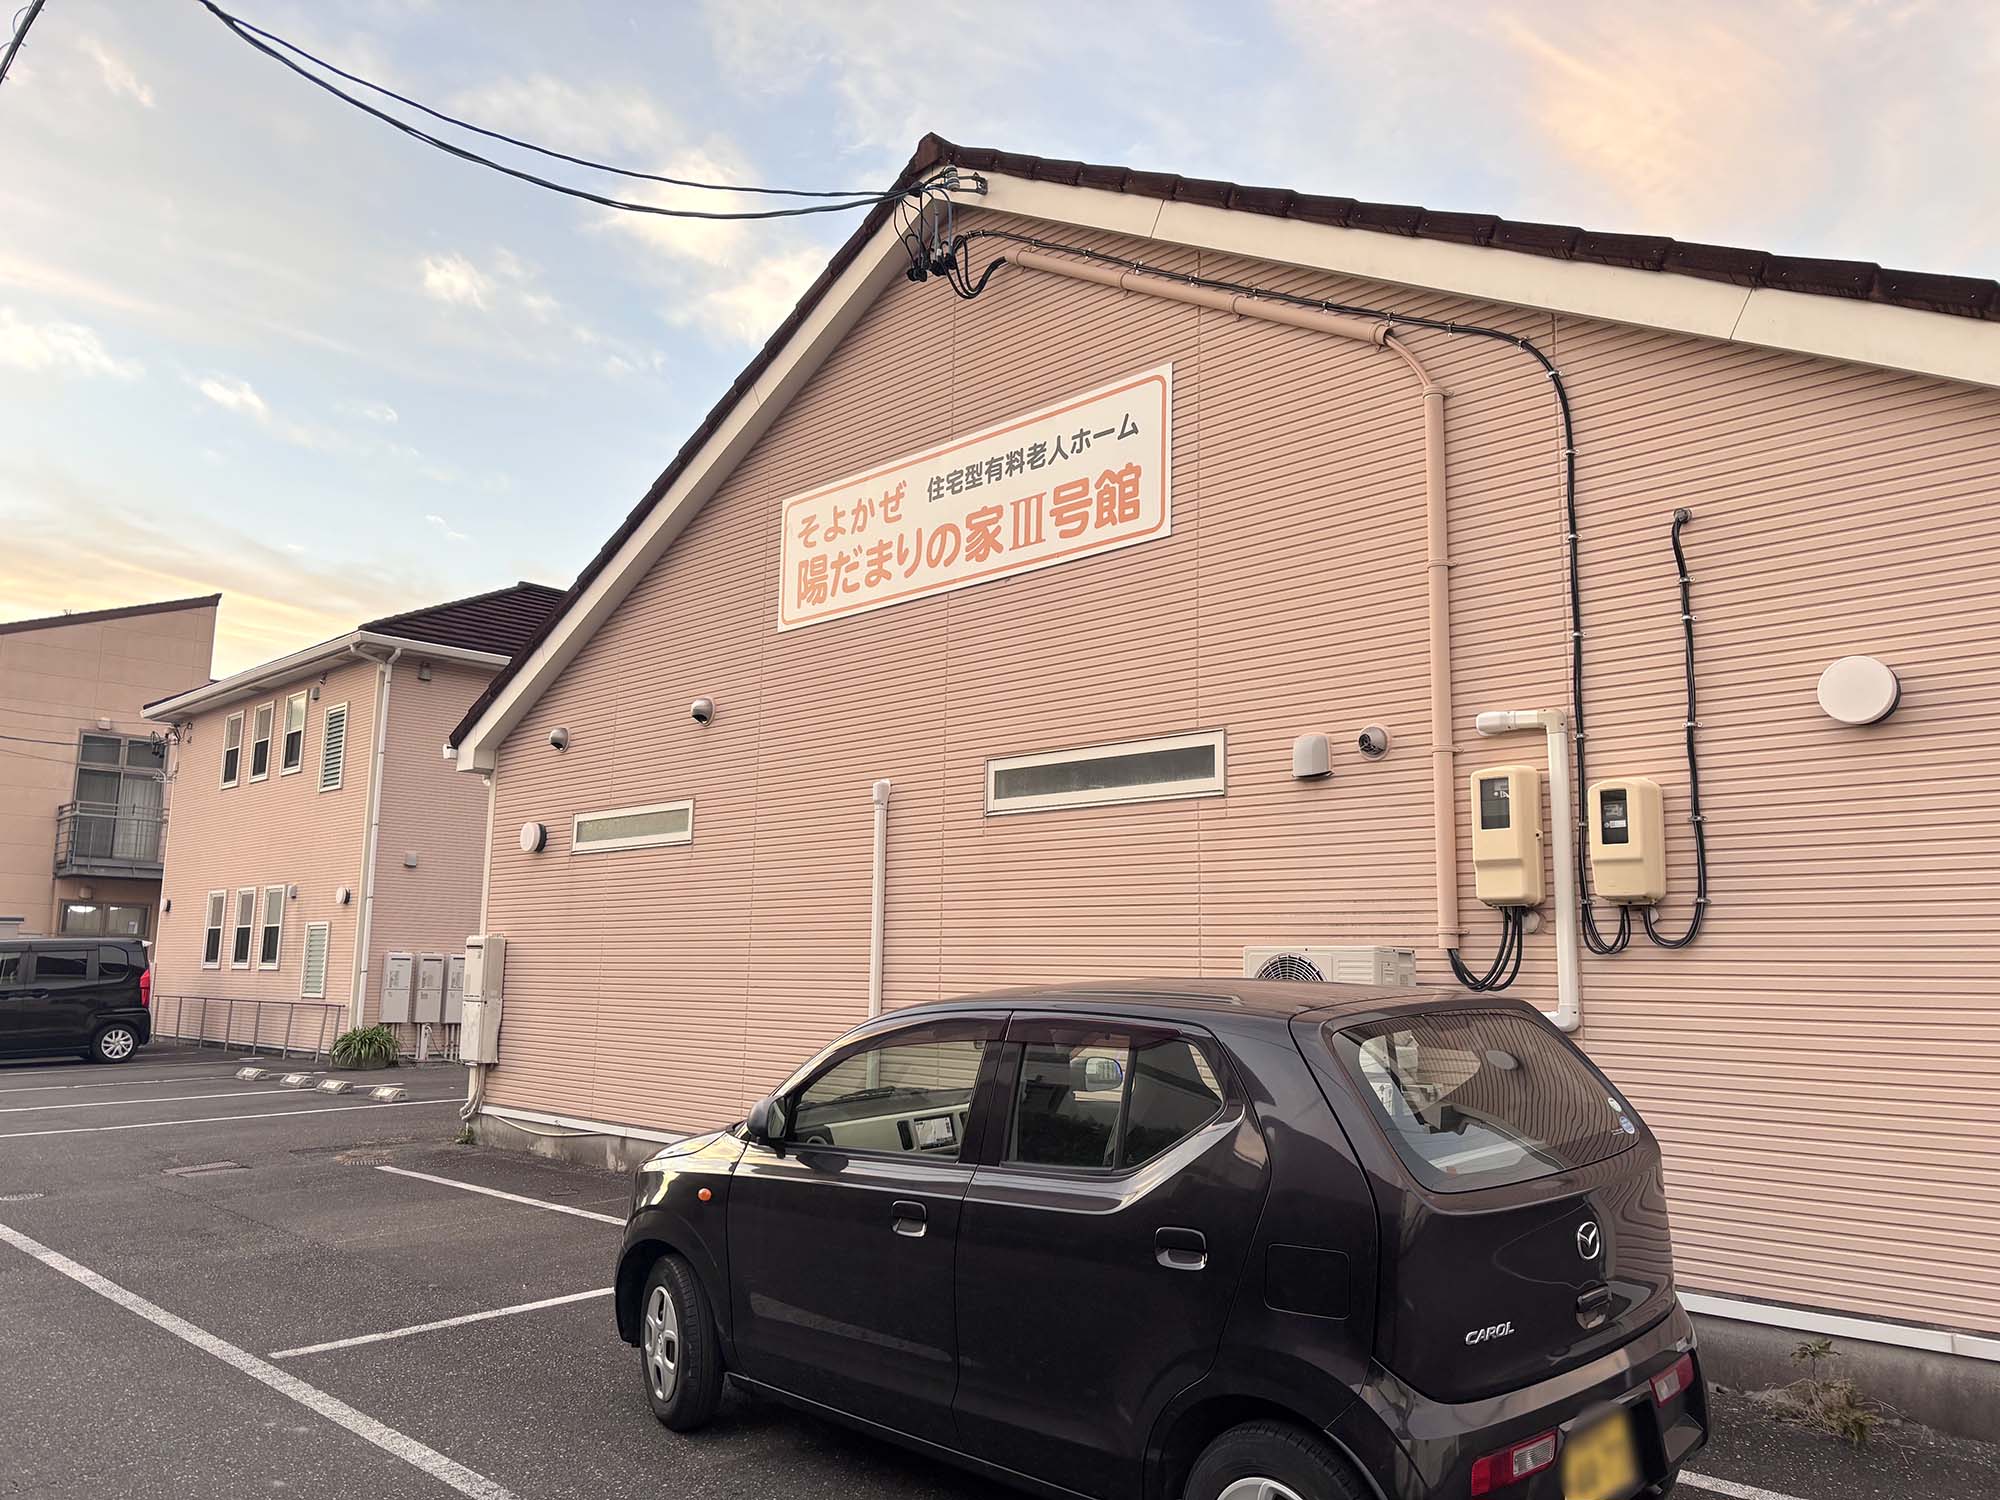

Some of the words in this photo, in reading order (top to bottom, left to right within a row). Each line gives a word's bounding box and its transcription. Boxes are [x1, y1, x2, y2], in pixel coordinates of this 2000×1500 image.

[927, 413, 1139, 502] 住宅型有料老人ホーム
[798, 480, 907, 549] そよかぜ
[1465, 1321, 1515, 1346] CAROL
